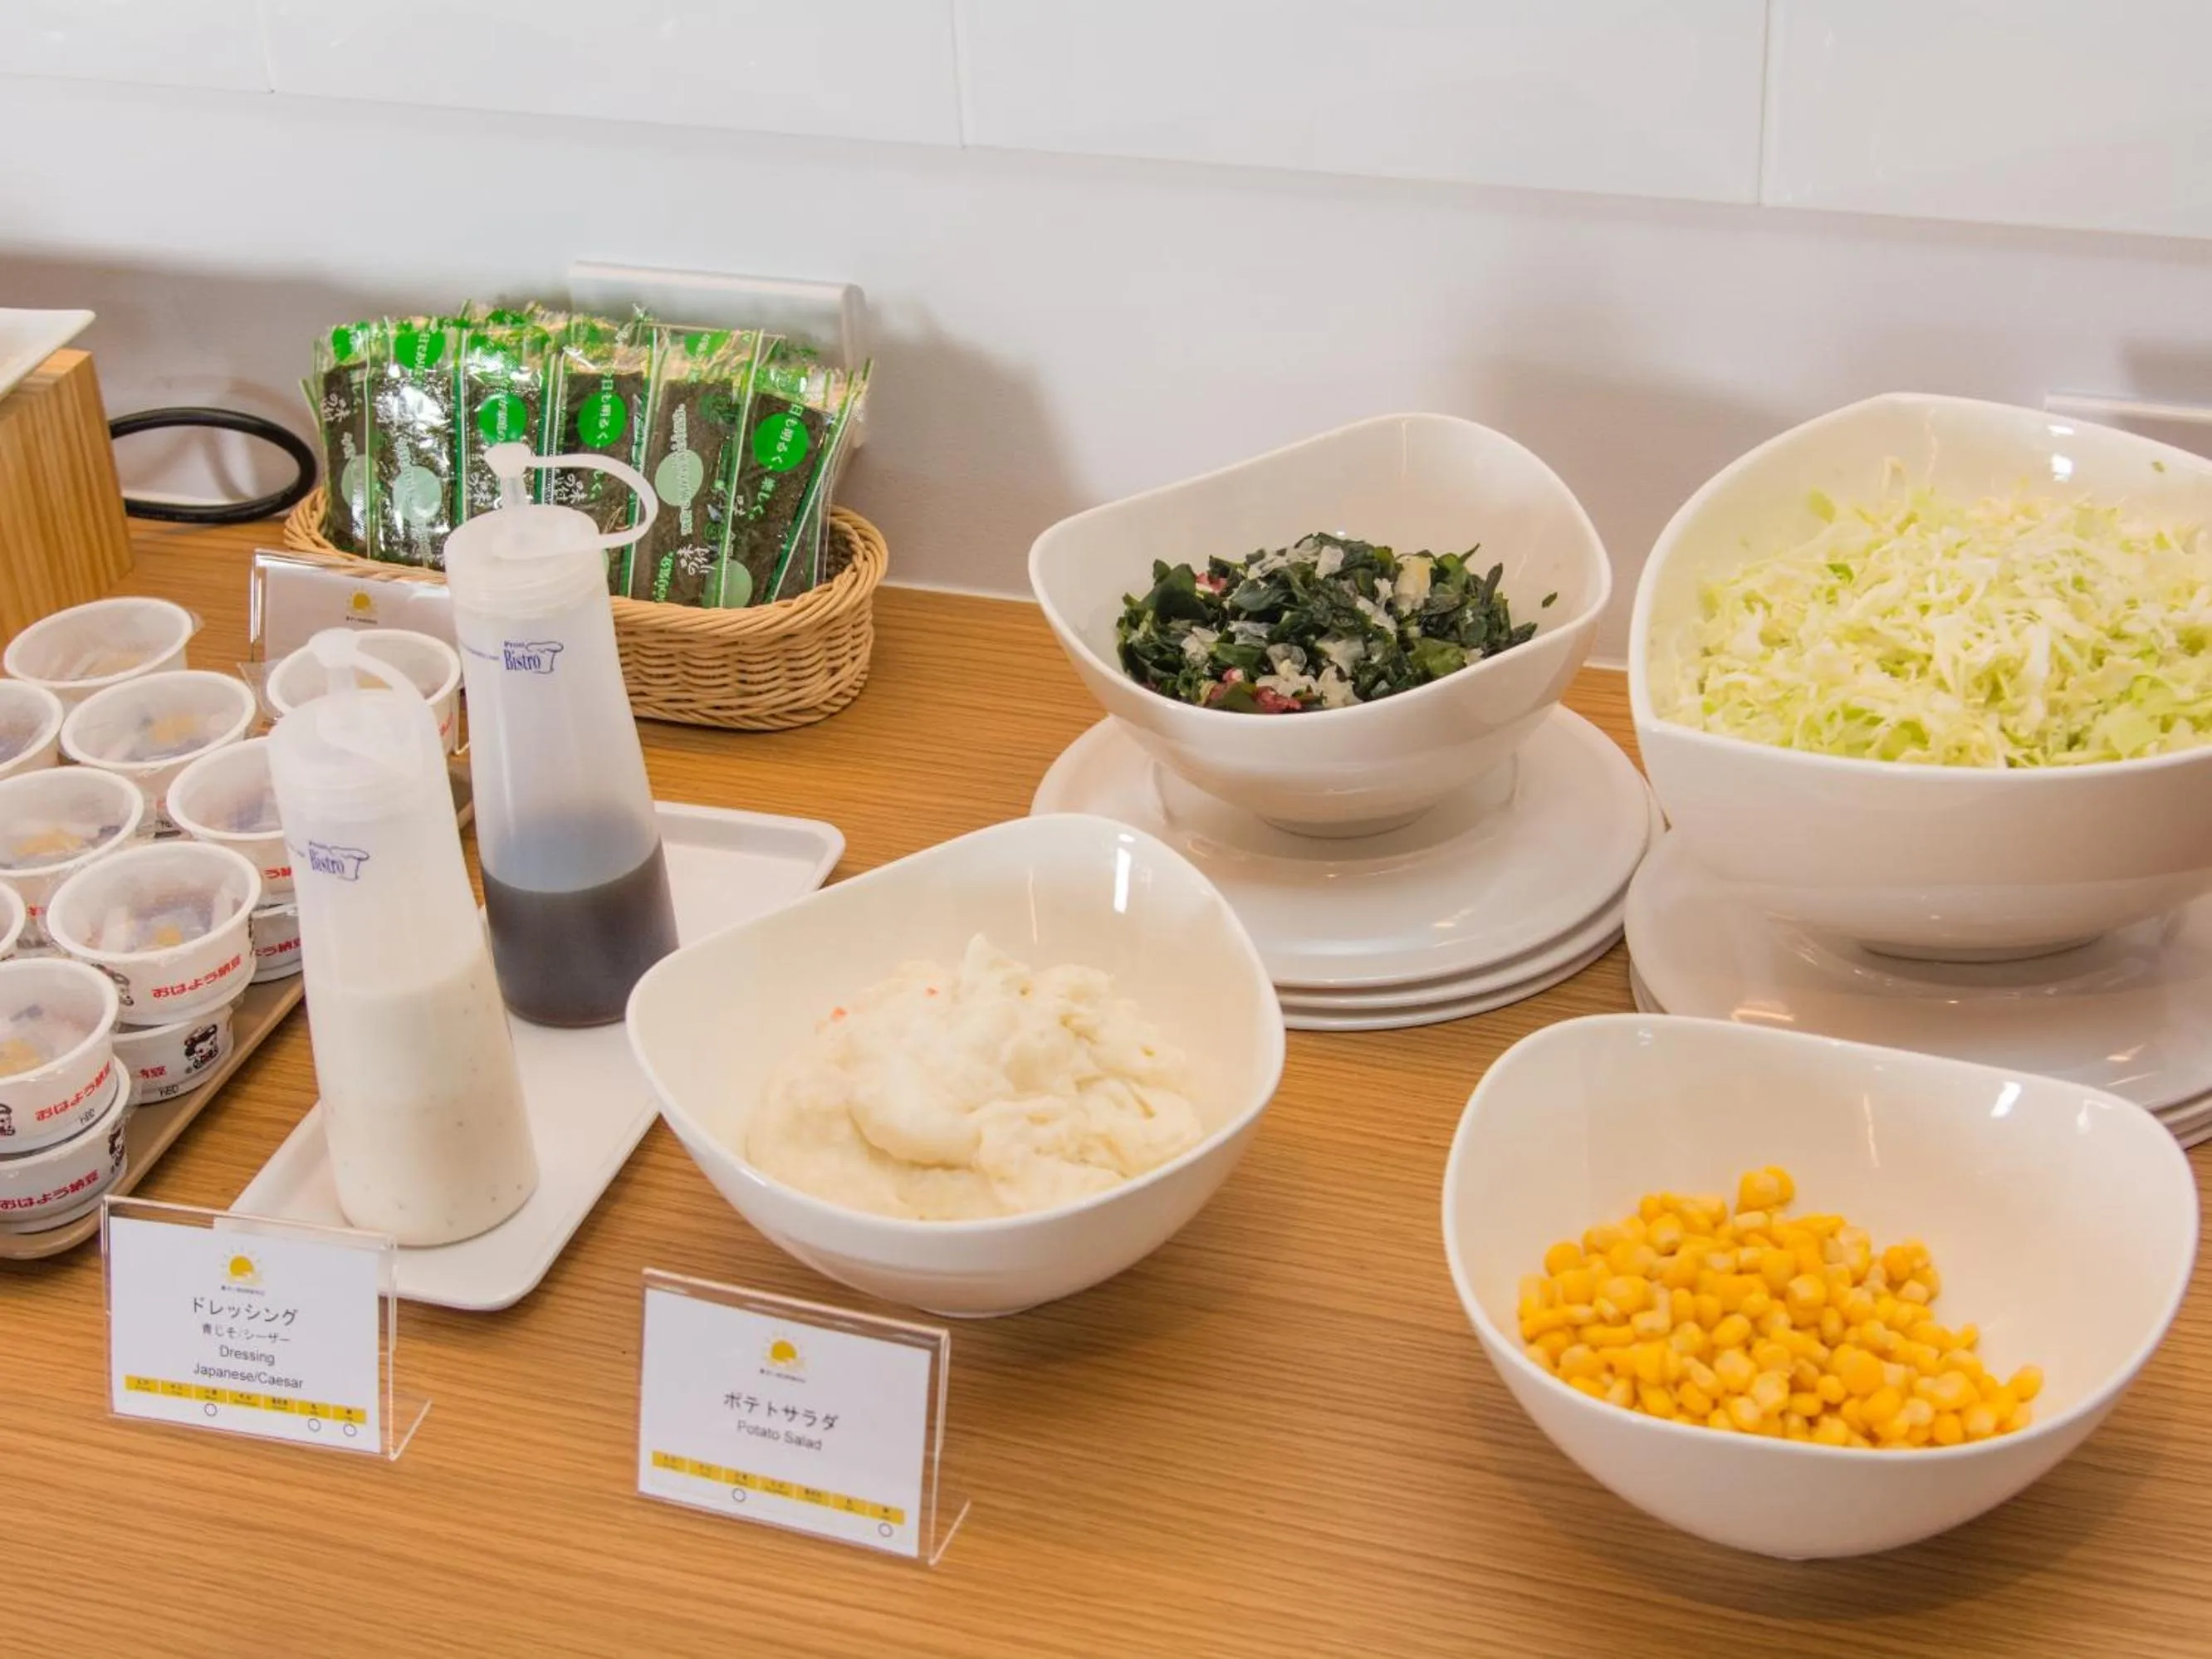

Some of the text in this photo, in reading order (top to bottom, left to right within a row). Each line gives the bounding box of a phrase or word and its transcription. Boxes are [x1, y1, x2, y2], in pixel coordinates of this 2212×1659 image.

[503, 648, 541, 671] Bistro
[151, 955, 242, 1000] おはよう納豆
[193, 1297, 299, 1327] ドレッシング
[219, 1344, 276, 1367] Dressing
[193, 1363, 305, 1389] Japanese/Caesar
[723, 1392, 839, 1431] ポテトサラダ
[737, 1419, 823, 1451] Potato Salad
